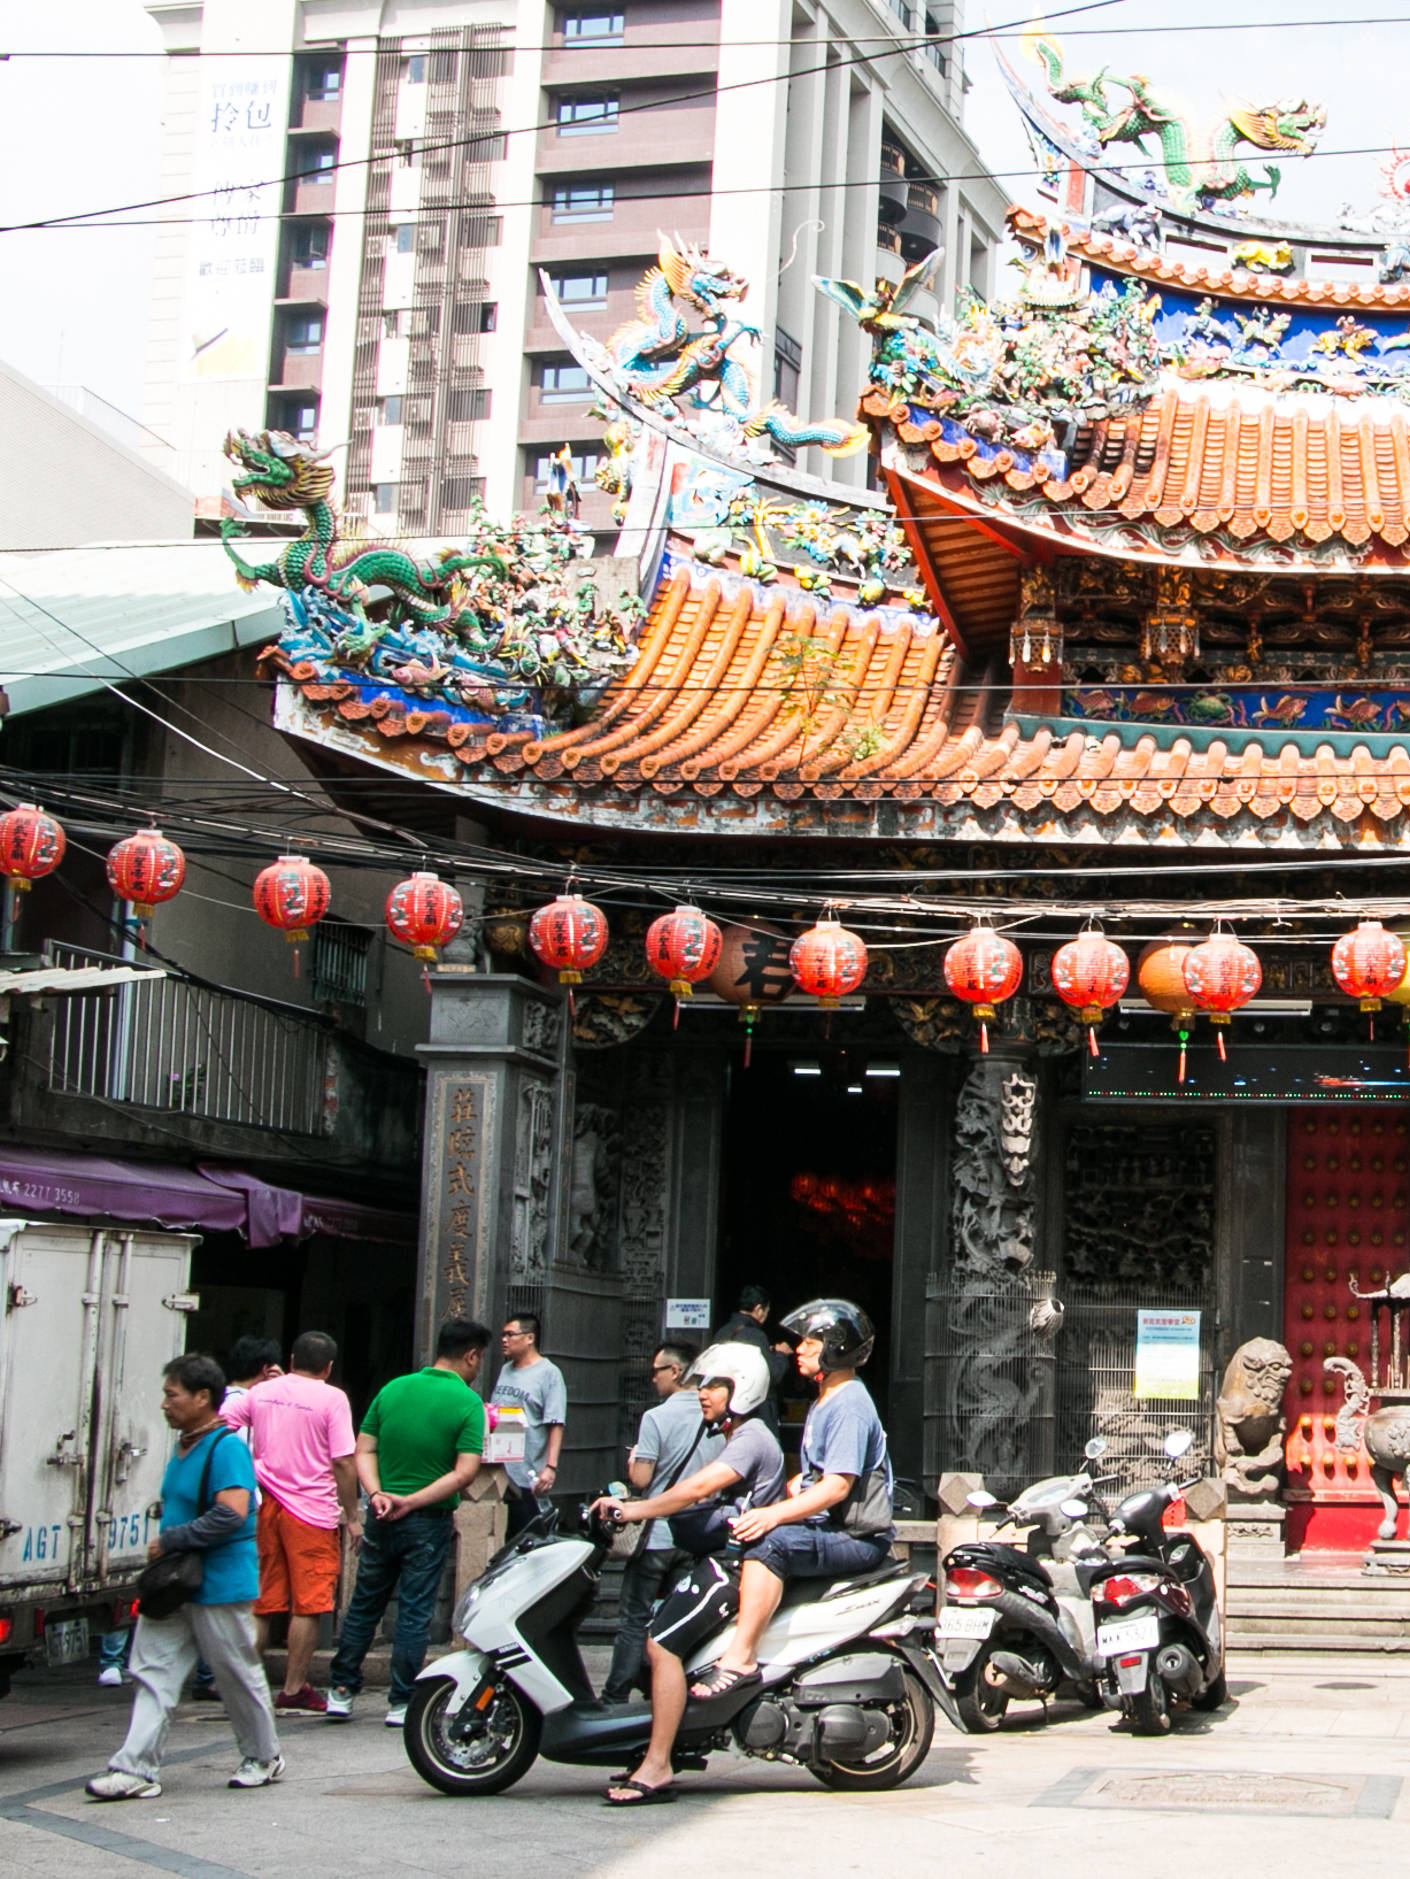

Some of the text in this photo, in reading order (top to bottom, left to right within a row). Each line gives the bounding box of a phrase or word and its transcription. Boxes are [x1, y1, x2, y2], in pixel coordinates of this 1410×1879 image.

[210, 100, 273, 134] 拎包
[24, 1183, 49, 1199] 2277
[22, 1514, 150, 1562] AGT 9751
